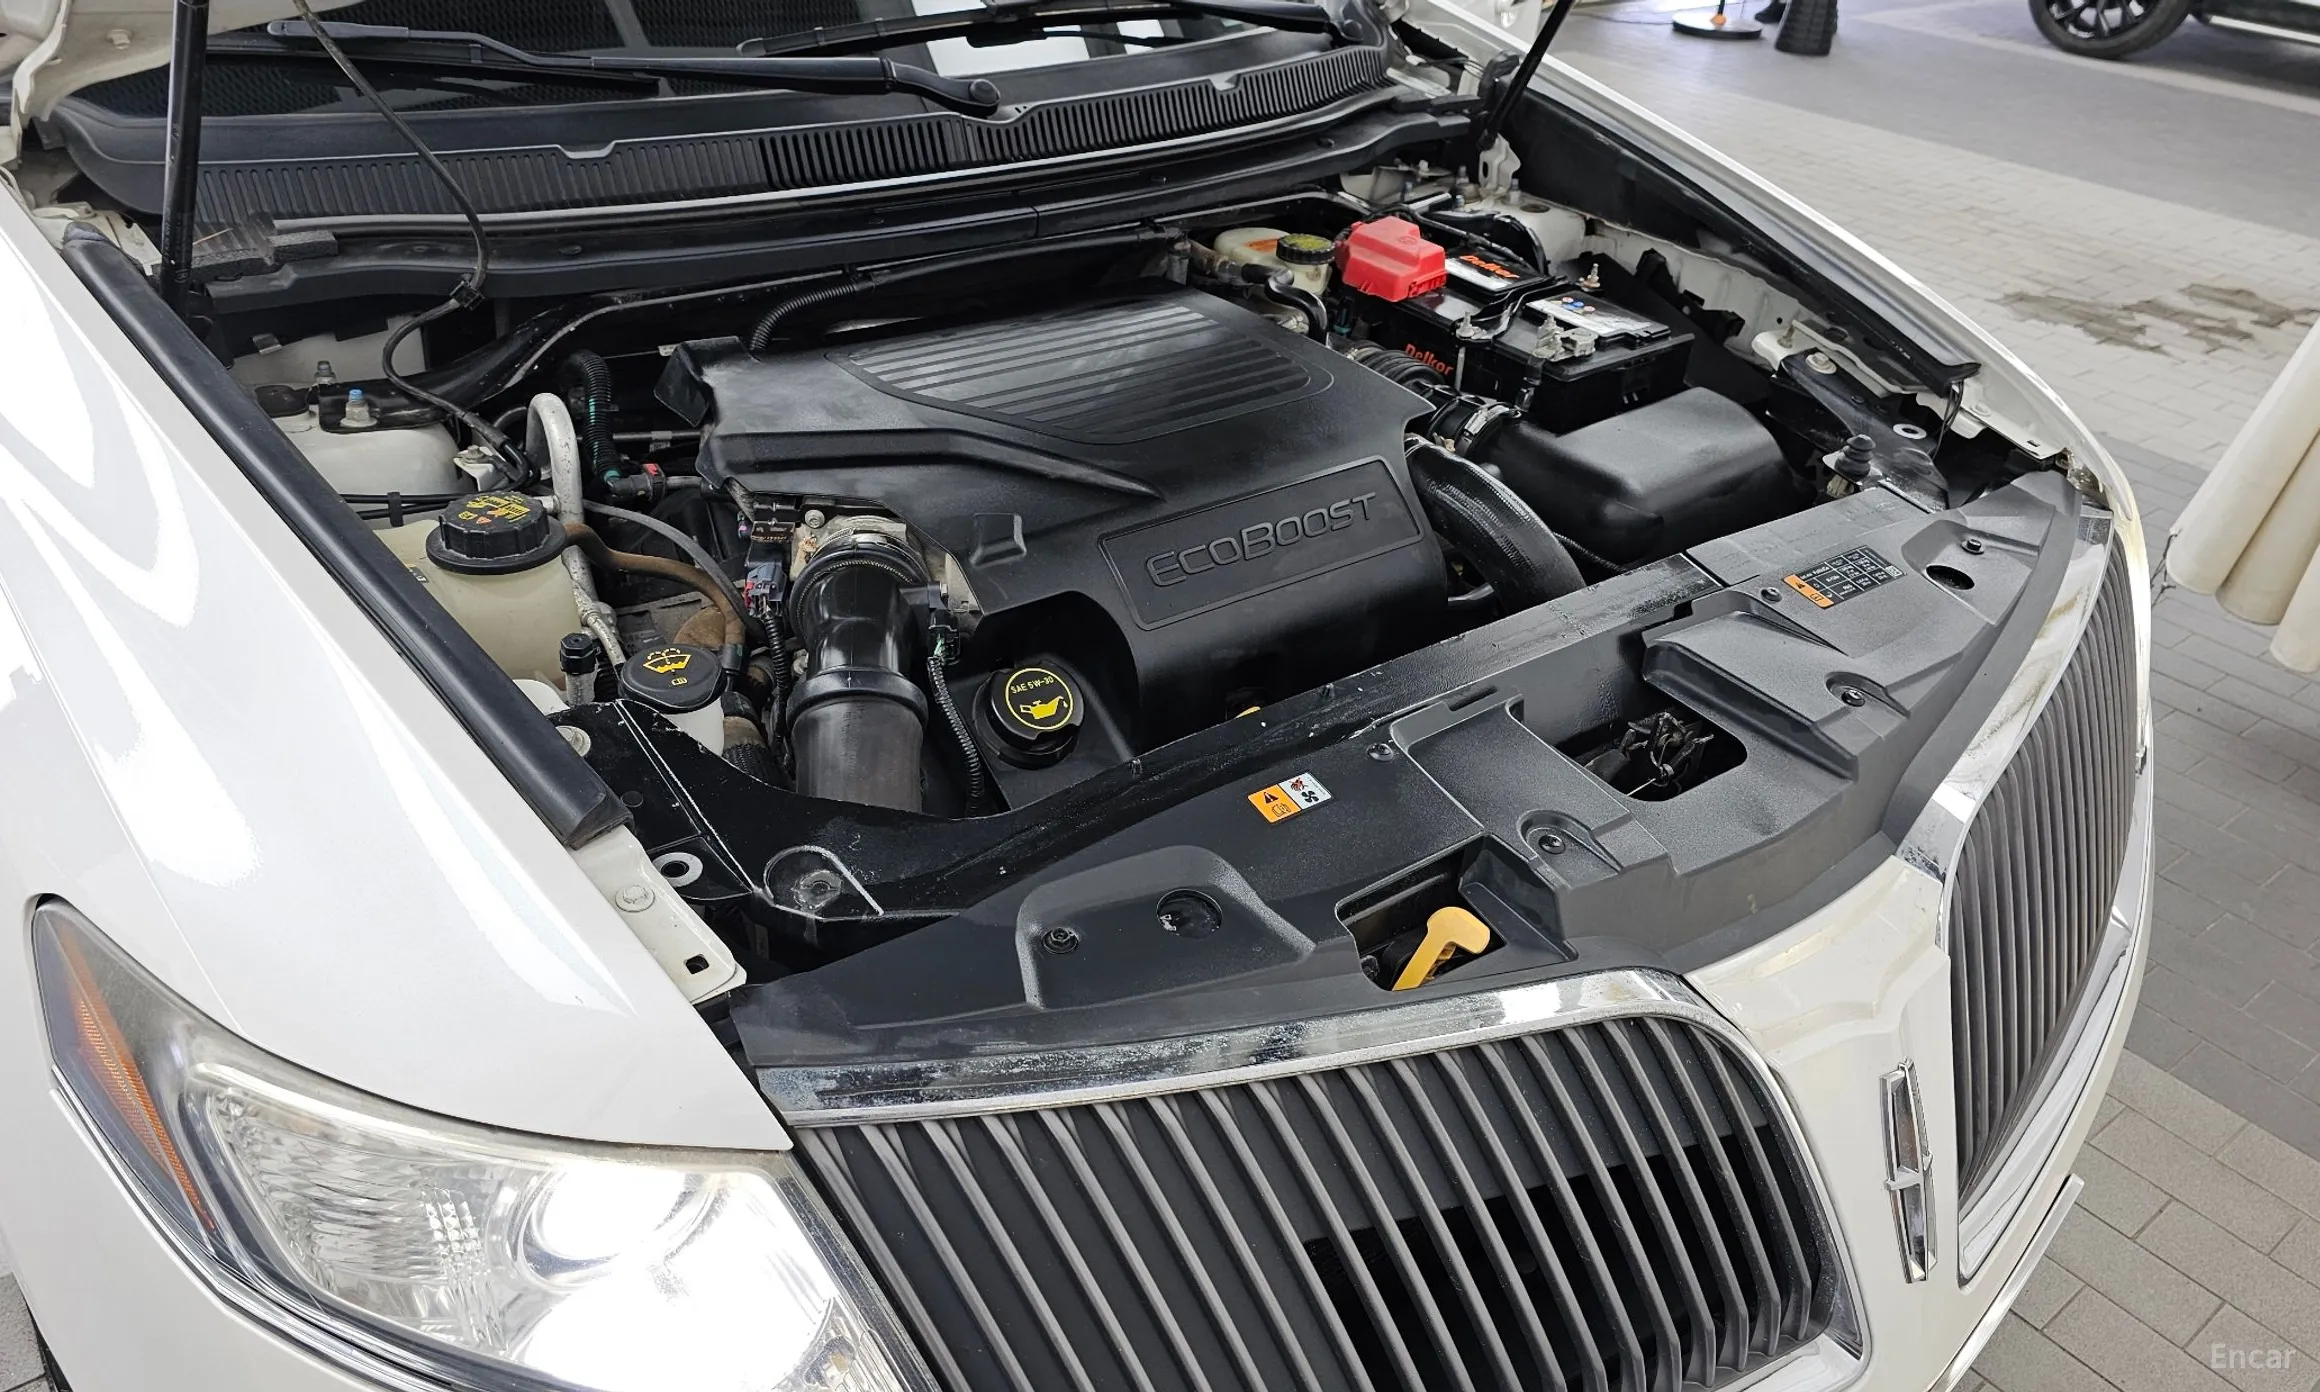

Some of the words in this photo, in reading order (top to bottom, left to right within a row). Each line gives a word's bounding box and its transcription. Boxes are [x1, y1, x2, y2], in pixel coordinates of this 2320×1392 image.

[1404, 343, 1454, 376] Delkor
[1010, 683, 1027, 694] SAE
[1028, 676, 1055, 690] 5W-30
